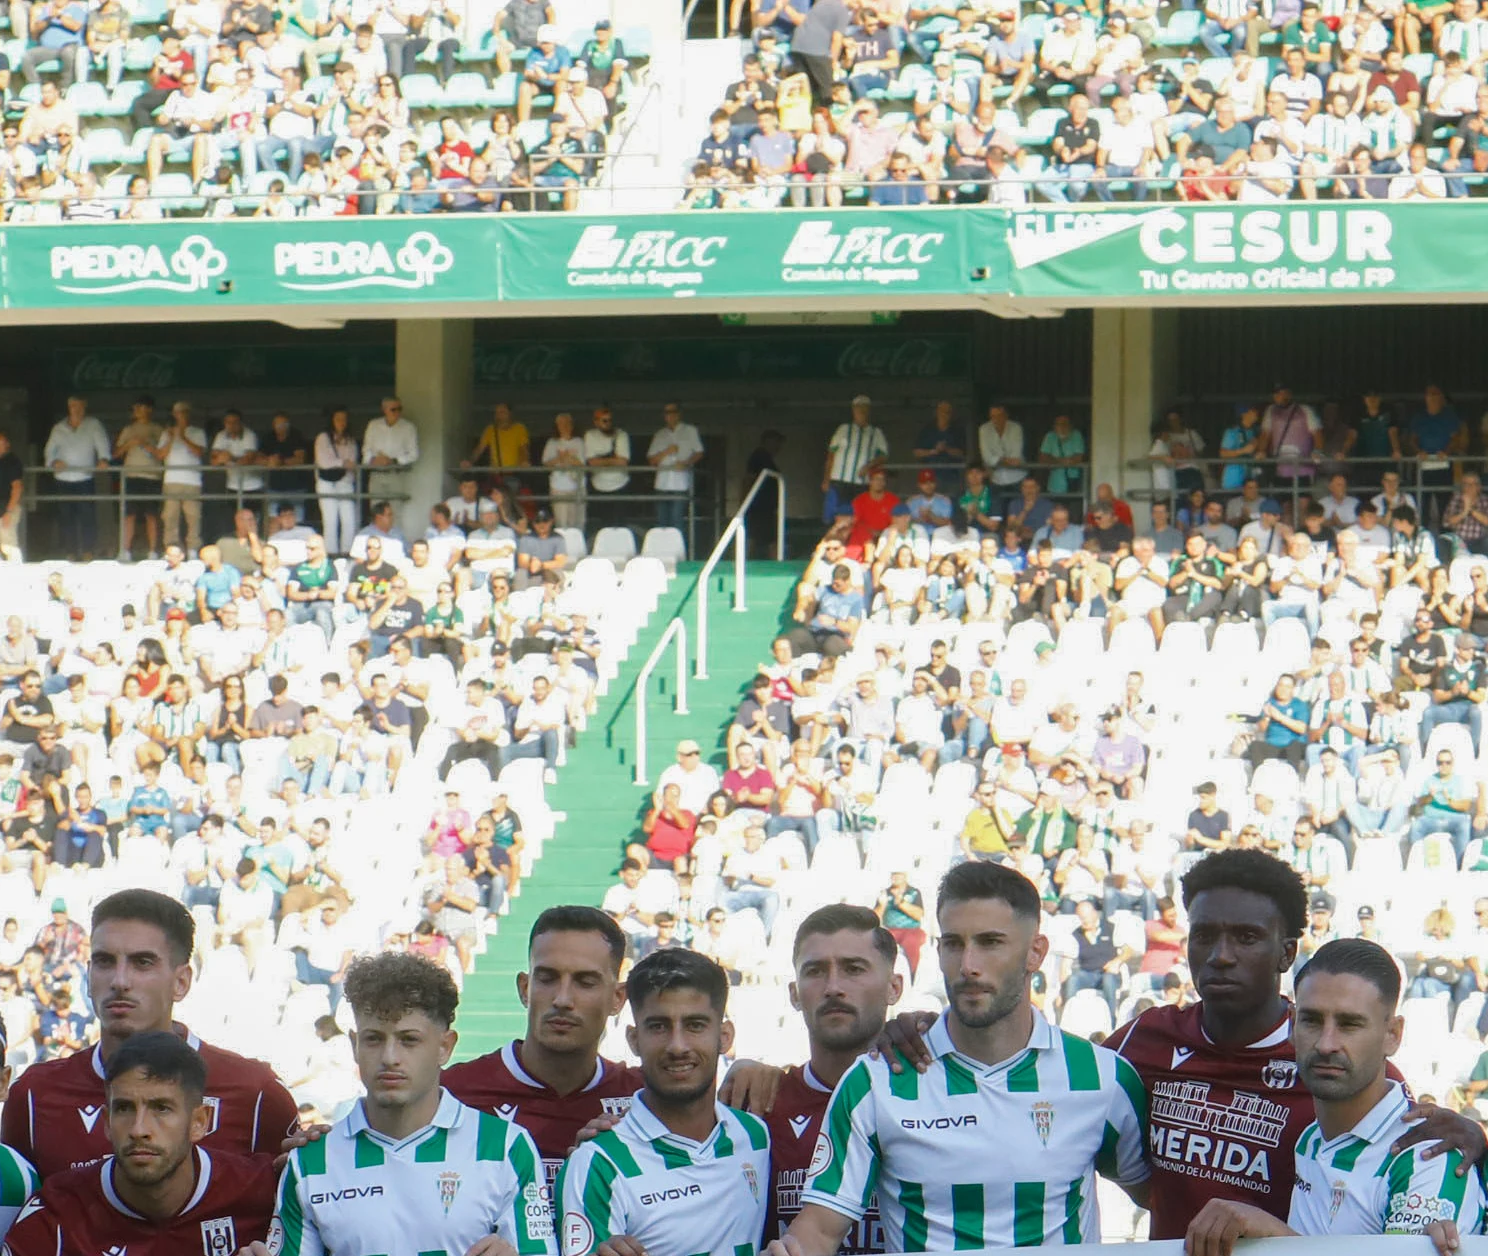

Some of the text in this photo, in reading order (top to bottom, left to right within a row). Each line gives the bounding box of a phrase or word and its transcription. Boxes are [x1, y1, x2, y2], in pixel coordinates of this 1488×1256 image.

[833, 232, 945, 264] PACC
[1139, 209, 1393, 264] CESUR
[51, 244, 170, 279] PIEDRA
[274, 241, 395, 276] PIEDRA
[618, 235, 728, 268] PACC
[1139, 266, 1396, 290] Tu Centro Oficial de FP
[901, 1115, 978, 1130] GIVOVA
[310, 1185, 384, 1205] GIVOVA
[640, 1184, 702, 1206] GIVOVA
[1212, 1172, 1271, 1194] HUMANIDAD
